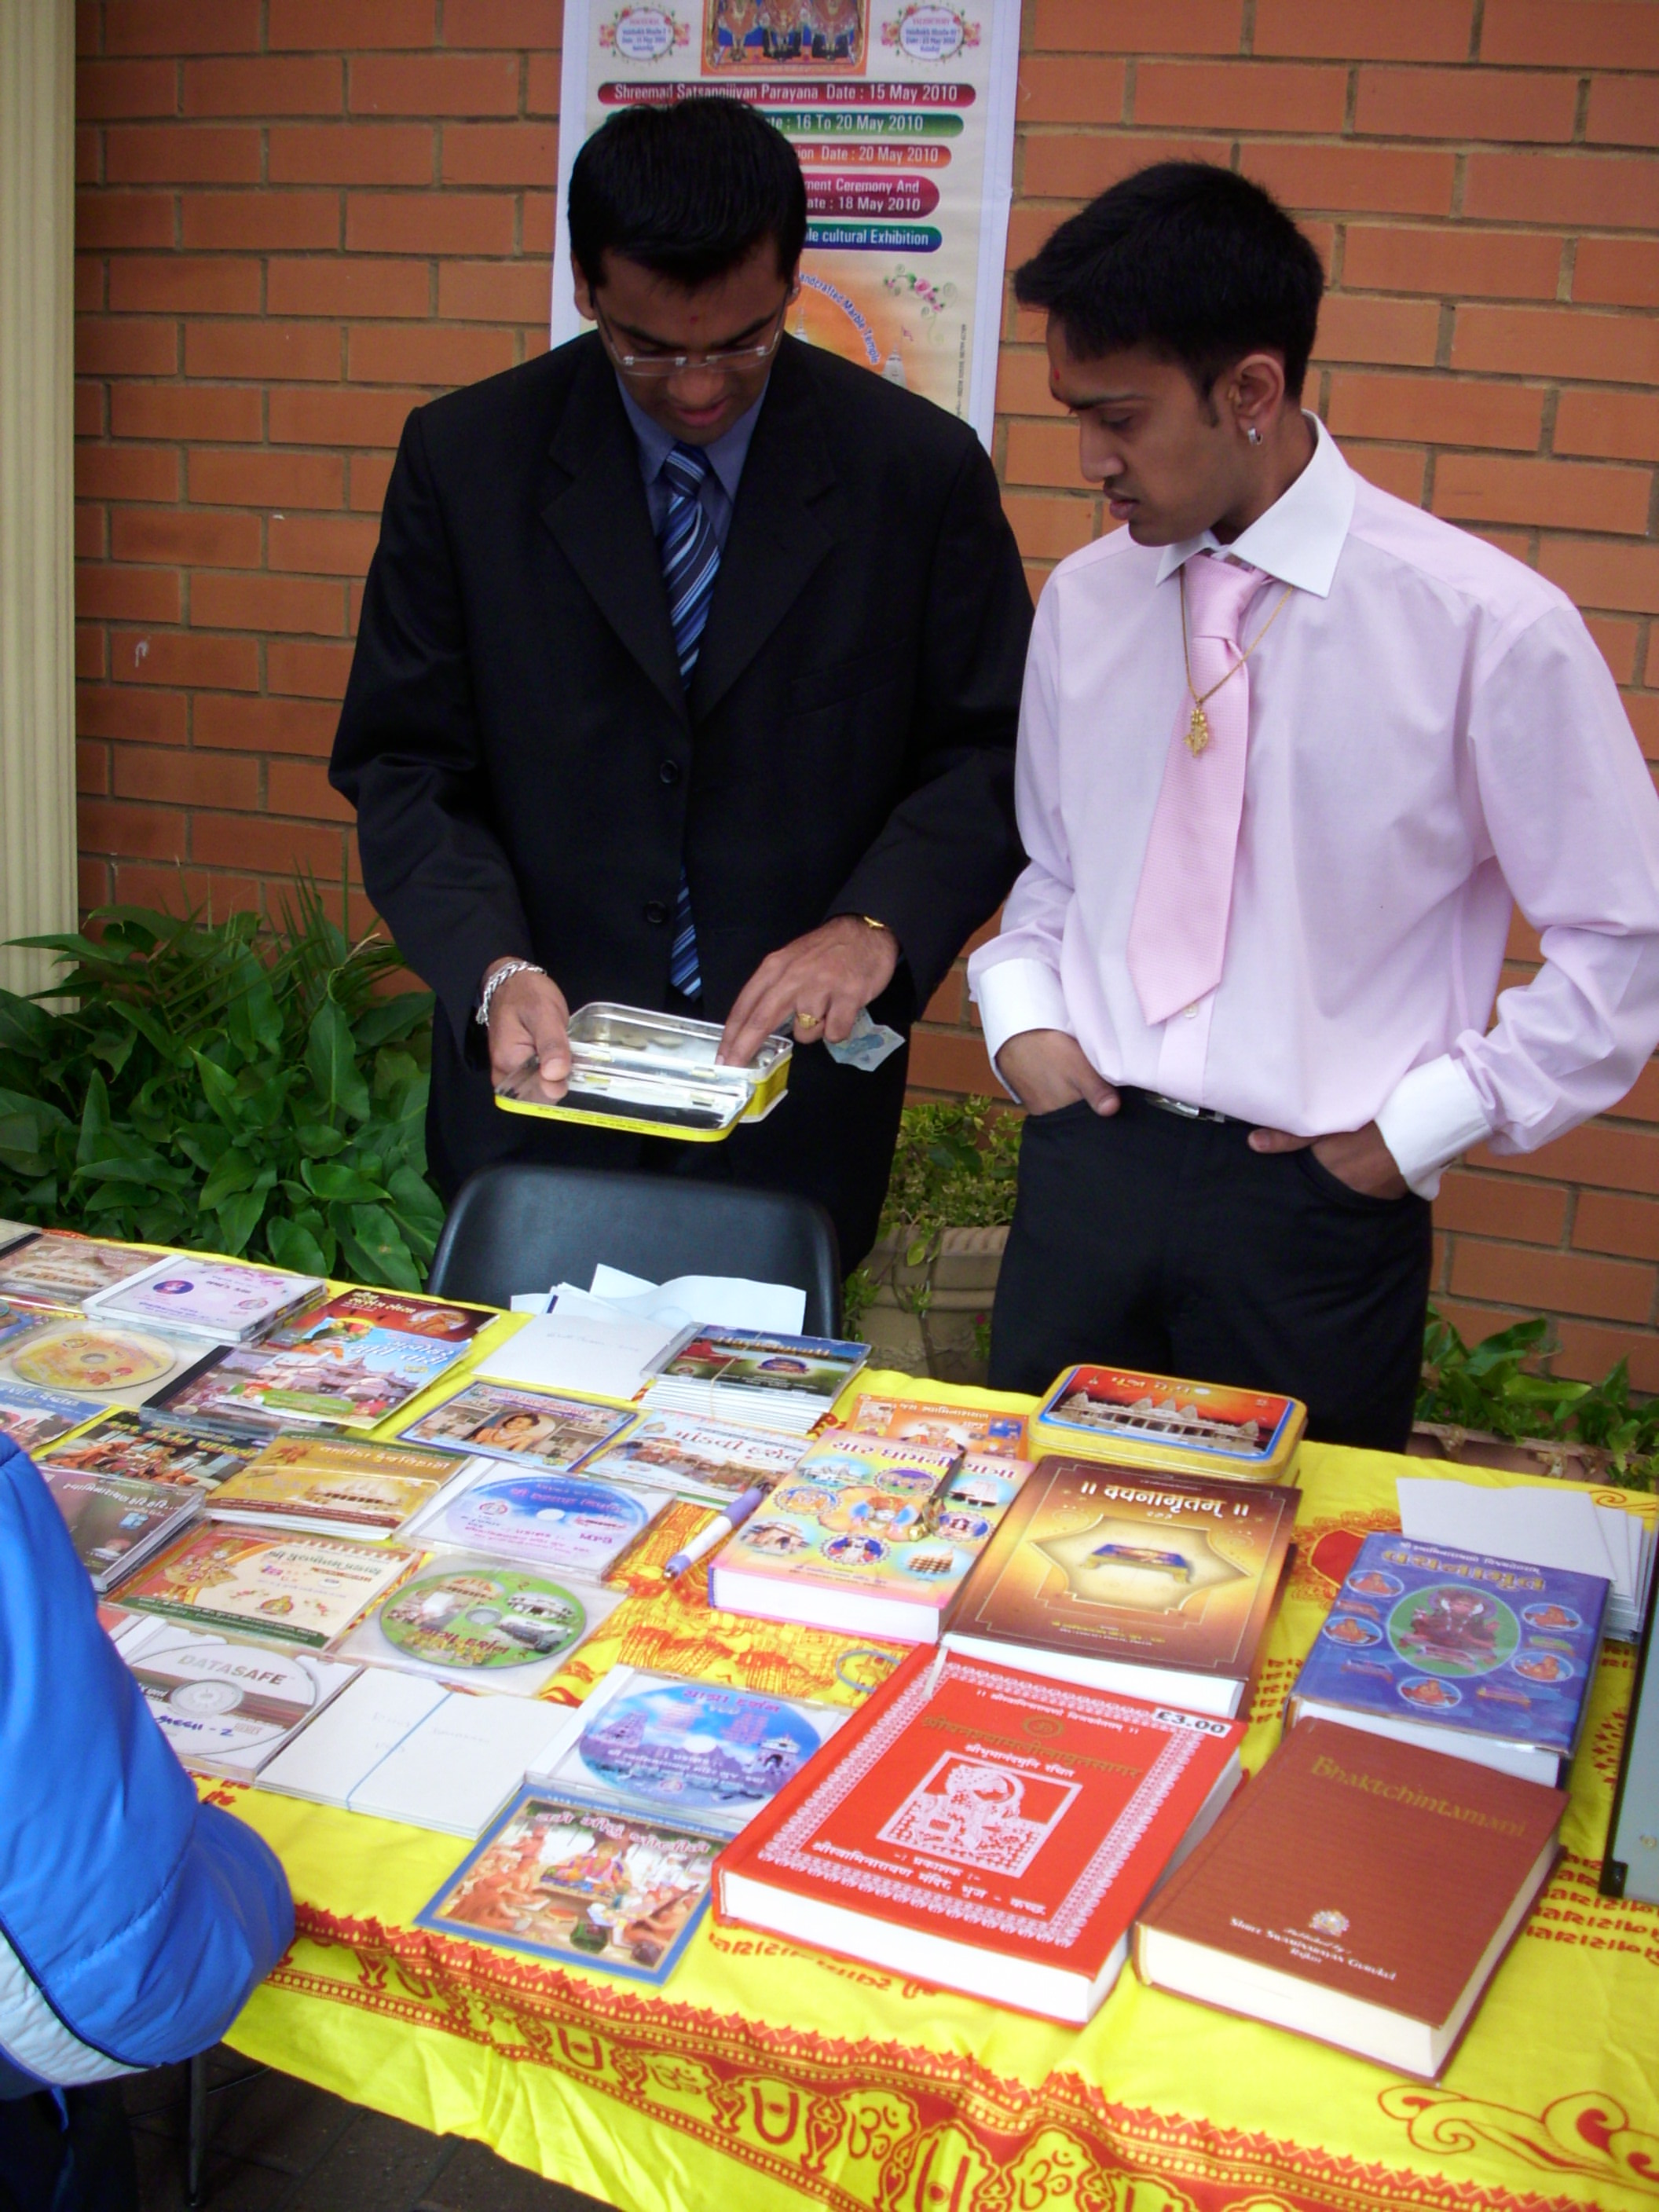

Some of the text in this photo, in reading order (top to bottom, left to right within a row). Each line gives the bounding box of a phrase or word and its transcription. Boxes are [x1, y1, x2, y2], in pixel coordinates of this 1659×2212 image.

[614, 83, 673, 100] Shreemad
[761, 84, 819, 104] Parayana
[826, 85, 856, 100] Date
[870, 85, 885, 100] 15
[890, 85, 917, 105] May
[922, 86, 958, 101] 2010
[796, 114, 811, 129] 16
[816, 114, 831, 129] To
[836, 115, 852, 130] 20
[857, 115, 884, 134] May
[888, 115, 924, 131] 2010
[821, 146, 848, 161] Date
[859, 146, 874, 161] 20
[878, 147, 903, 165] May
[907, 148, 939, 163] 2010
[836, 178, 892, 195] Ceremony
[896, 180, 920, 193] And
[808, 198, 826, 209] ate
[839, 196, 853, 209] 18
[857, 196, 884, 212] May
[888, 198, 921, 211] 2010
[822, 229, 866, 244] cultural
[870, 229, 929, 246] Exhibition
[799, 272, 881, 364] andcrafted Marble Temple
[63, 1482, 128, 1503] સ્વામિનારાયણ
[1103, 1484, 1228, 1518] वचनामृतम्
[1381, 1549, 1546, 1592] વચનામૃત
[178, 1654, 287, 1686] DATASAFE
[1155, 1709, 1227, 1734] £3.00
